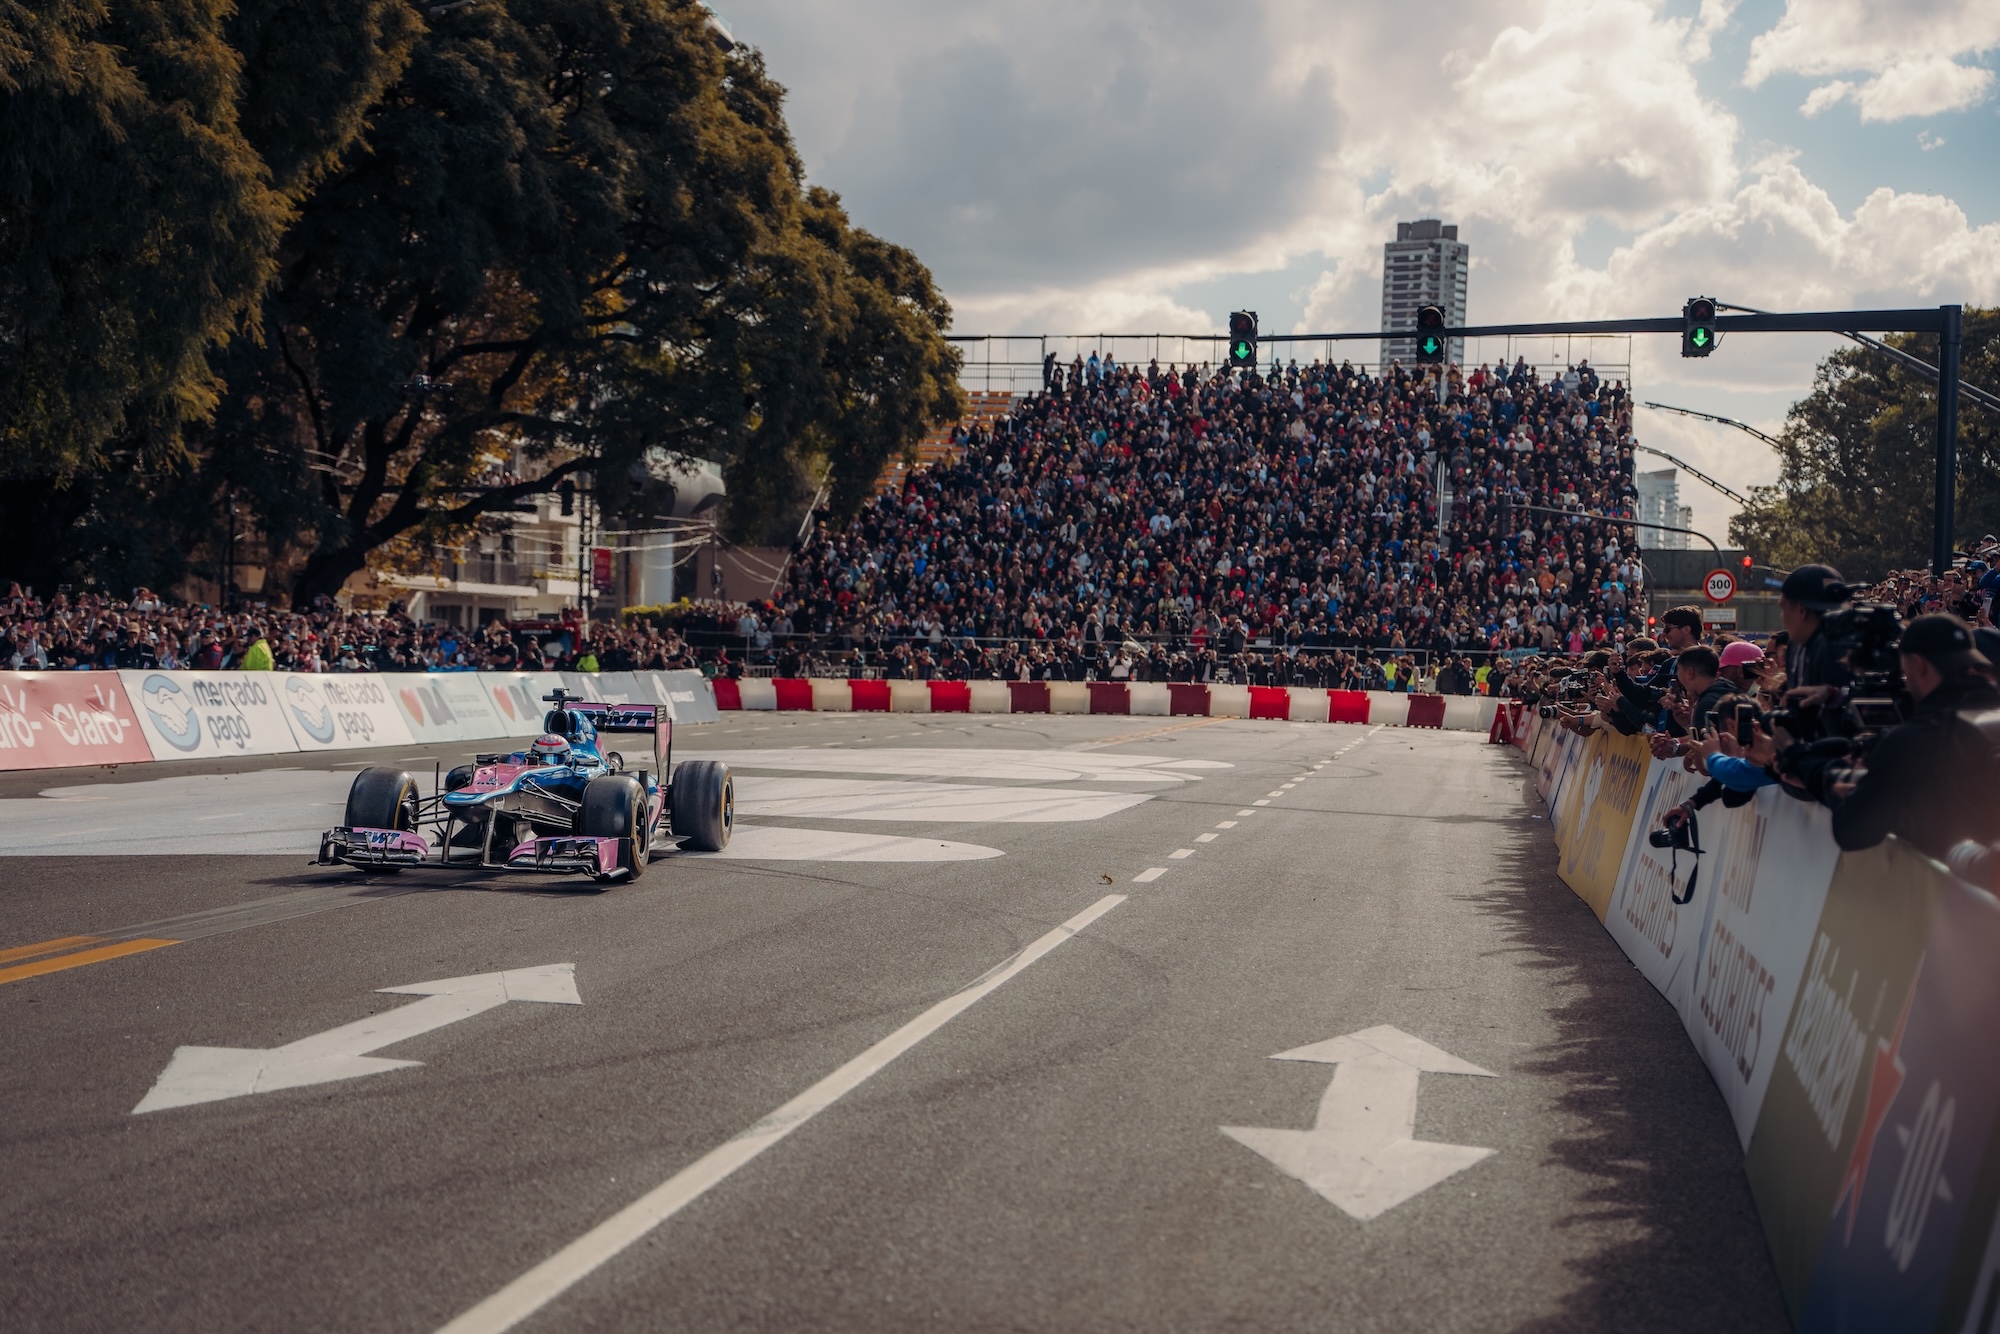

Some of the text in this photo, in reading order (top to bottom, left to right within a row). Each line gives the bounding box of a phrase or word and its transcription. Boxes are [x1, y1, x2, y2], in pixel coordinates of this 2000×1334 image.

[1709, 580, 1731, 589] 300
[193, 674, 267, 706] mercado
[323, 677, 385, 705] mercado
[52, 702, 124, 746] Claro
[207, 714, 251, 749] pago
[338, 711, 375, 742] pago
[1600, 745, 1642, 817] mercado
[1626, 851, 1686, 960] SECURITIES
[1700, 918, 1776, 1086] SECURITIES
[1786, 931, 1868, 1153] Heineken
